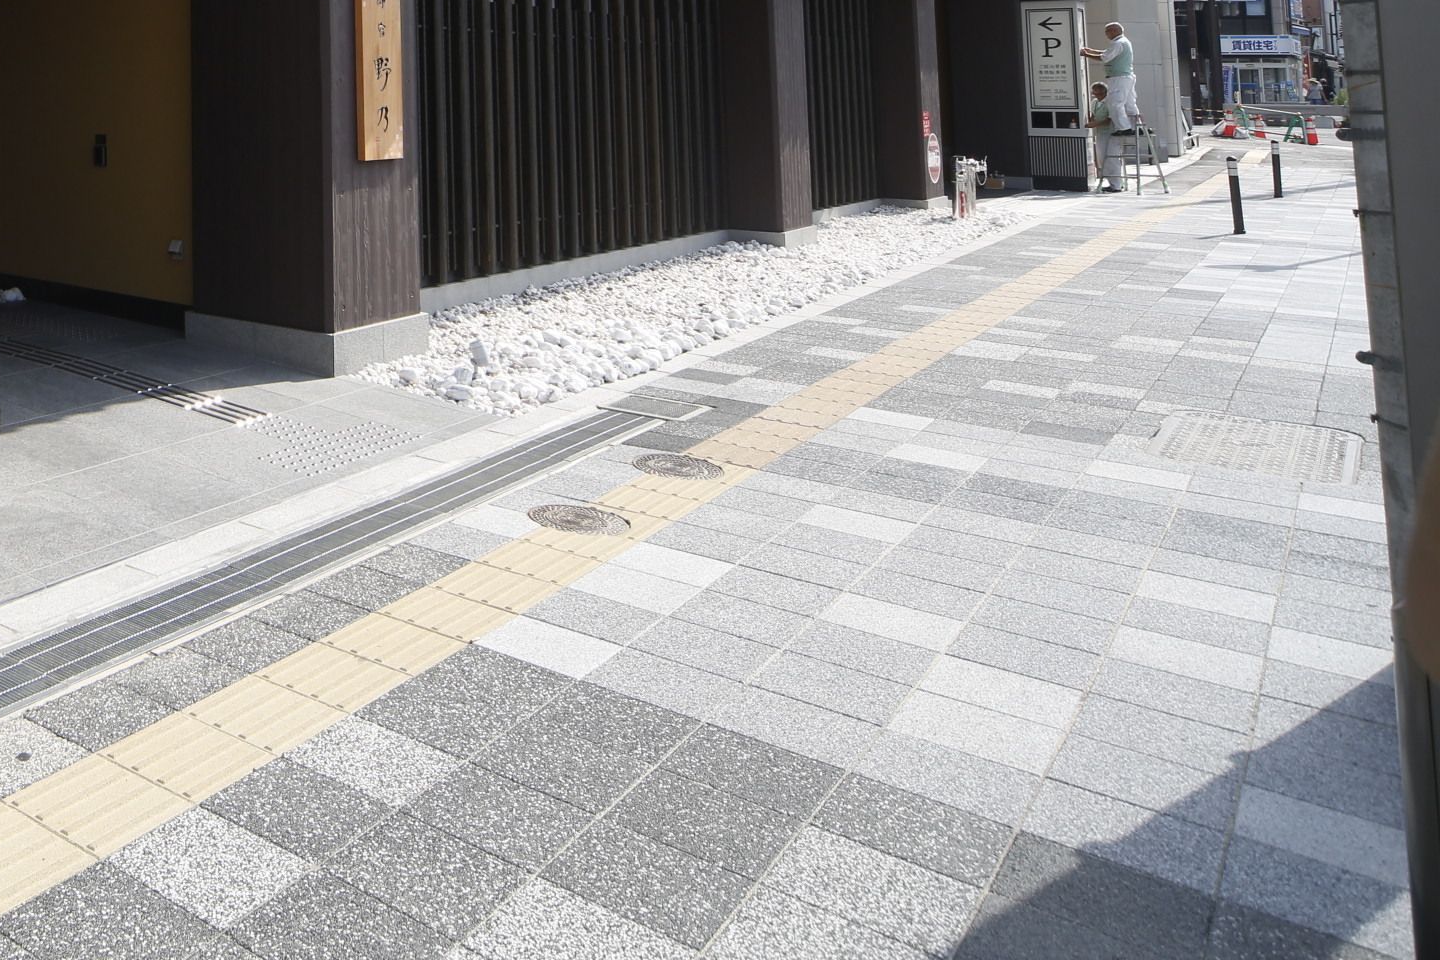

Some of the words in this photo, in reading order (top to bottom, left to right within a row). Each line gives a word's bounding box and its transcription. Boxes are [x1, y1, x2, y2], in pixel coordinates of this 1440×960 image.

[1040, 37, 1062, 58] P
[1232, 40, 1273, 51] 賃貸住宅
